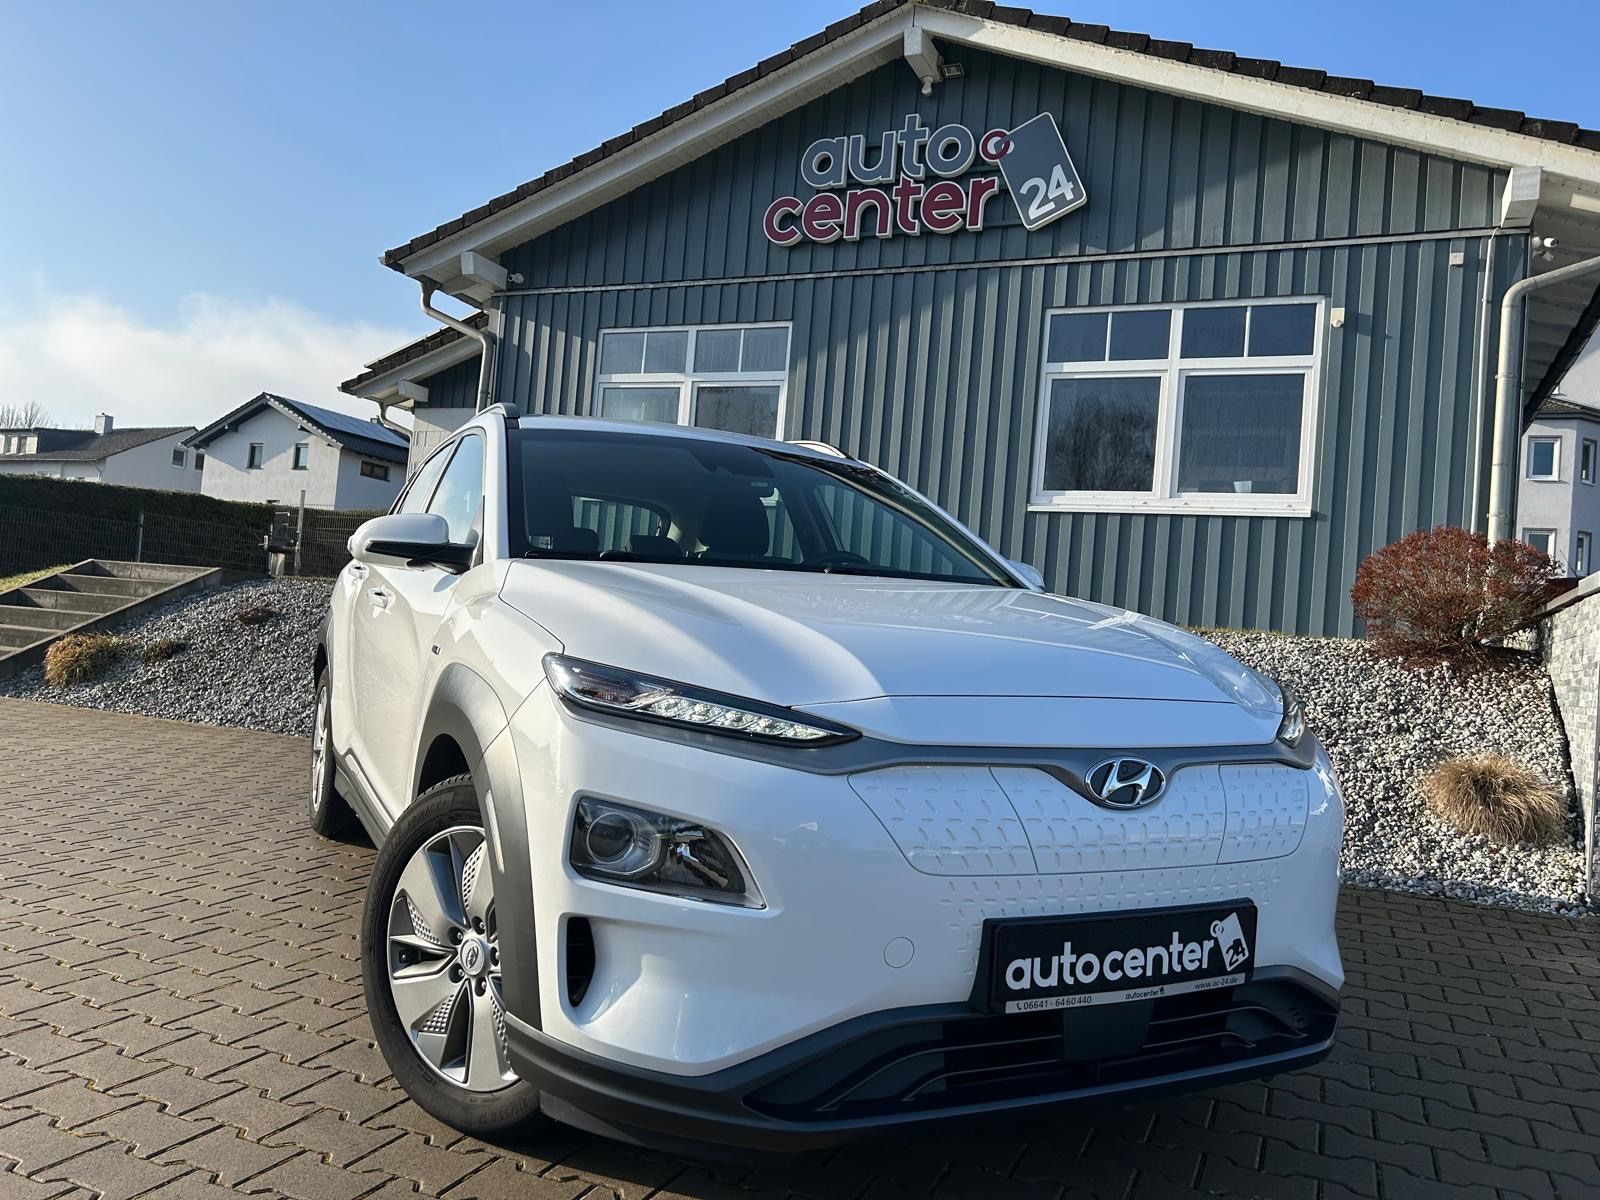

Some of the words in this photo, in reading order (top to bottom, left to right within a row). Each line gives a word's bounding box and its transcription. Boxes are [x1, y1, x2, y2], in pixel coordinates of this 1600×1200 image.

[801, 113, 975, 189] auto
[763, 171, 998, 247] center
[1019, 163, 1074, 220] 24
[1005, 931, 1215, 990] autocenter
[1225, 937, 1246, 967] 24
[1194, 976, 1238, 990] www.ac-24.de
[1023, 1000, 1048, 1010] 06641
[1125, 988, 1159, 1000] autocenter
